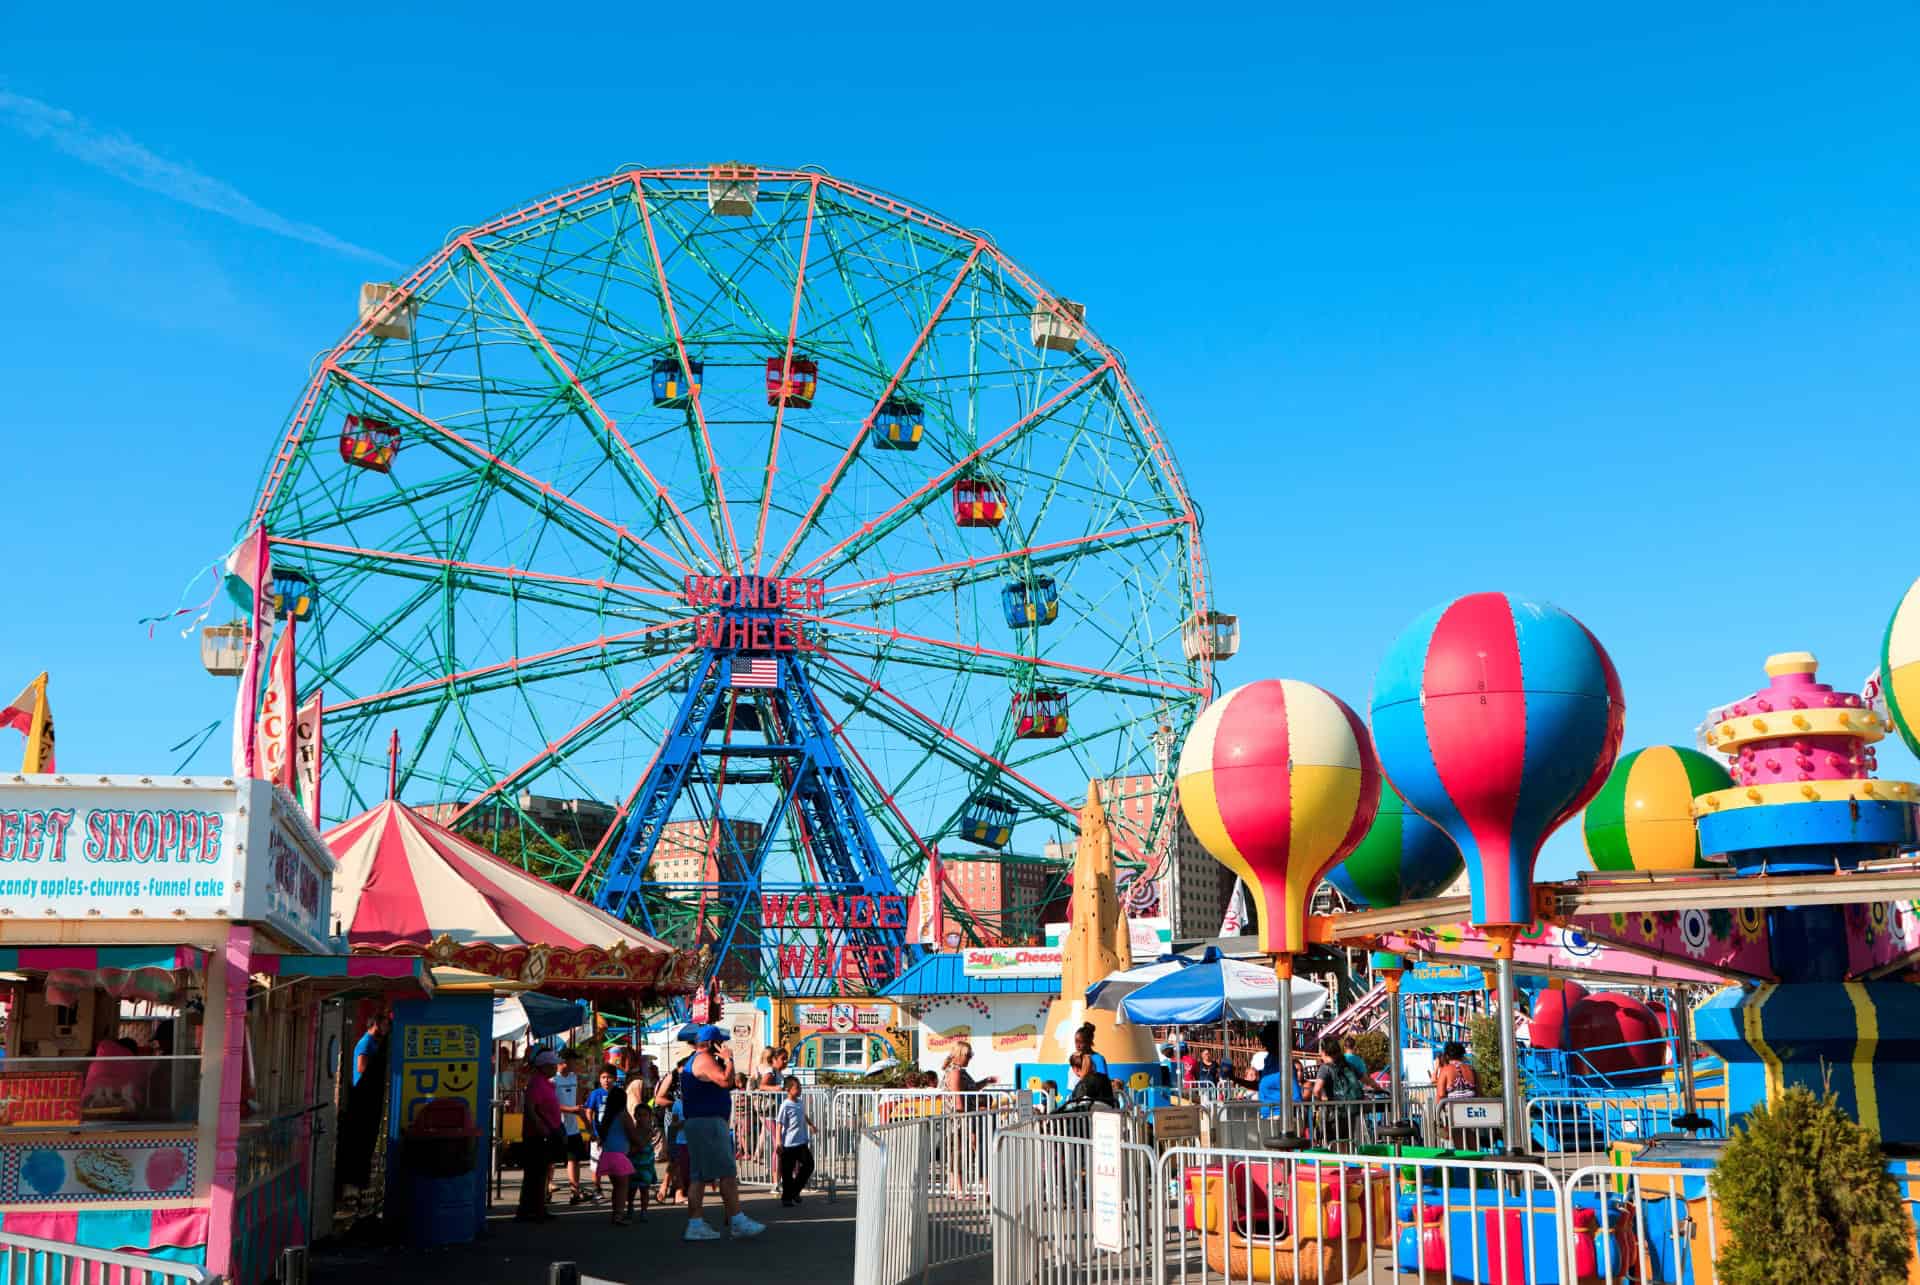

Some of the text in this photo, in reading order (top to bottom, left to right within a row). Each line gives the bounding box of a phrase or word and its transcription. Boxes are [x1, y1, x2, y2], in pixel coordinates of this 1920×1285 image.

[684, 575, 825, 609] WONDER
[694, 616, 817, 650] WHEEL
[84, 808, 223, 864] SHOPPE
[0, 878, 224, 898] candy apples churros funnel cake
[761, 895, 918, 928] WONDE
[968, 952, 1062, 966] Say Cheese
[1466, 1106, 1487, 1118] Exit
